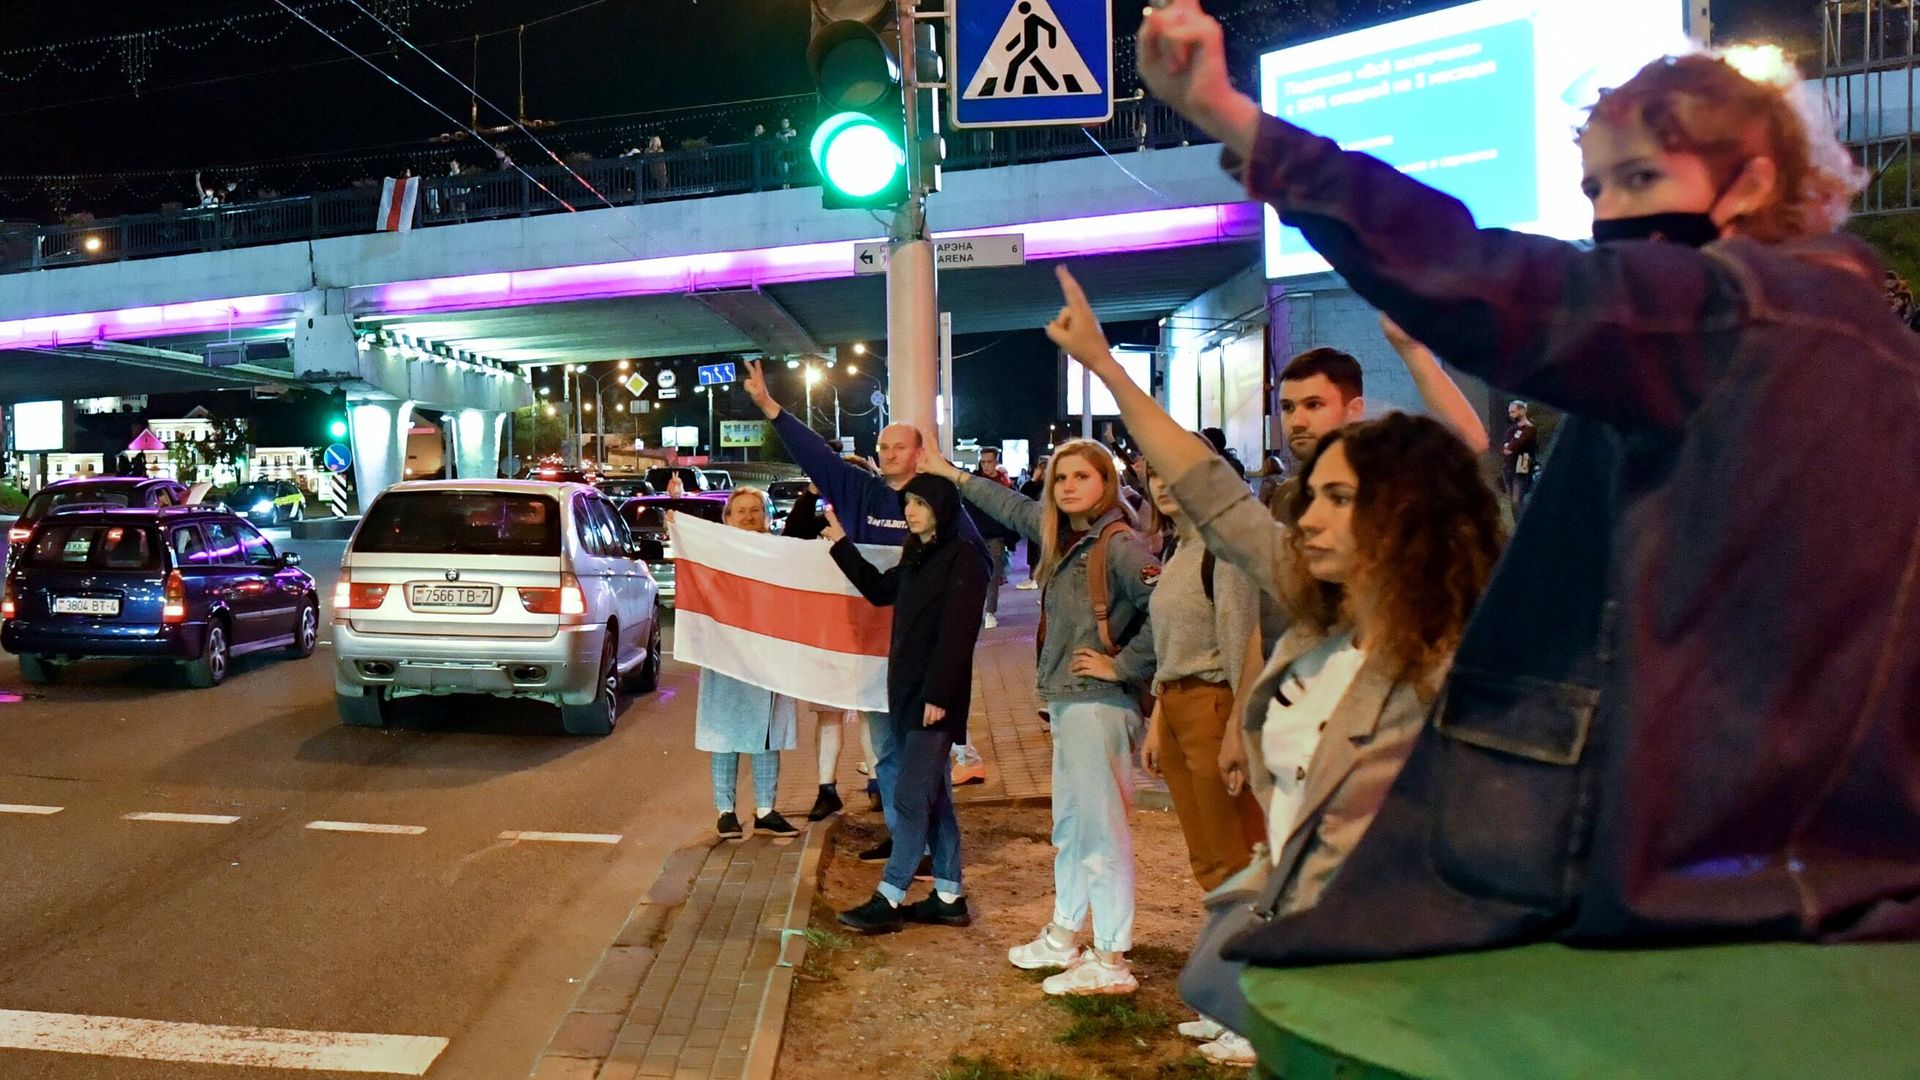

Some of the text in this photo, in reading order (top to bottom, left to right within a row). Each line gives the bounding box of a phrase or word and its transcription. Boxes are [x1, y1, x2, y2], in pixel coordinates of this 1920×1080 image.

[937, 242, 973, 252] АРЭНА
[1011, 245, 1018, 253] 6
[938, 254, 974, 263] ARENA
[426, 589, 489, 603] 7566 TB-7
[67, 601, 116, 612] 3804 BT-4
